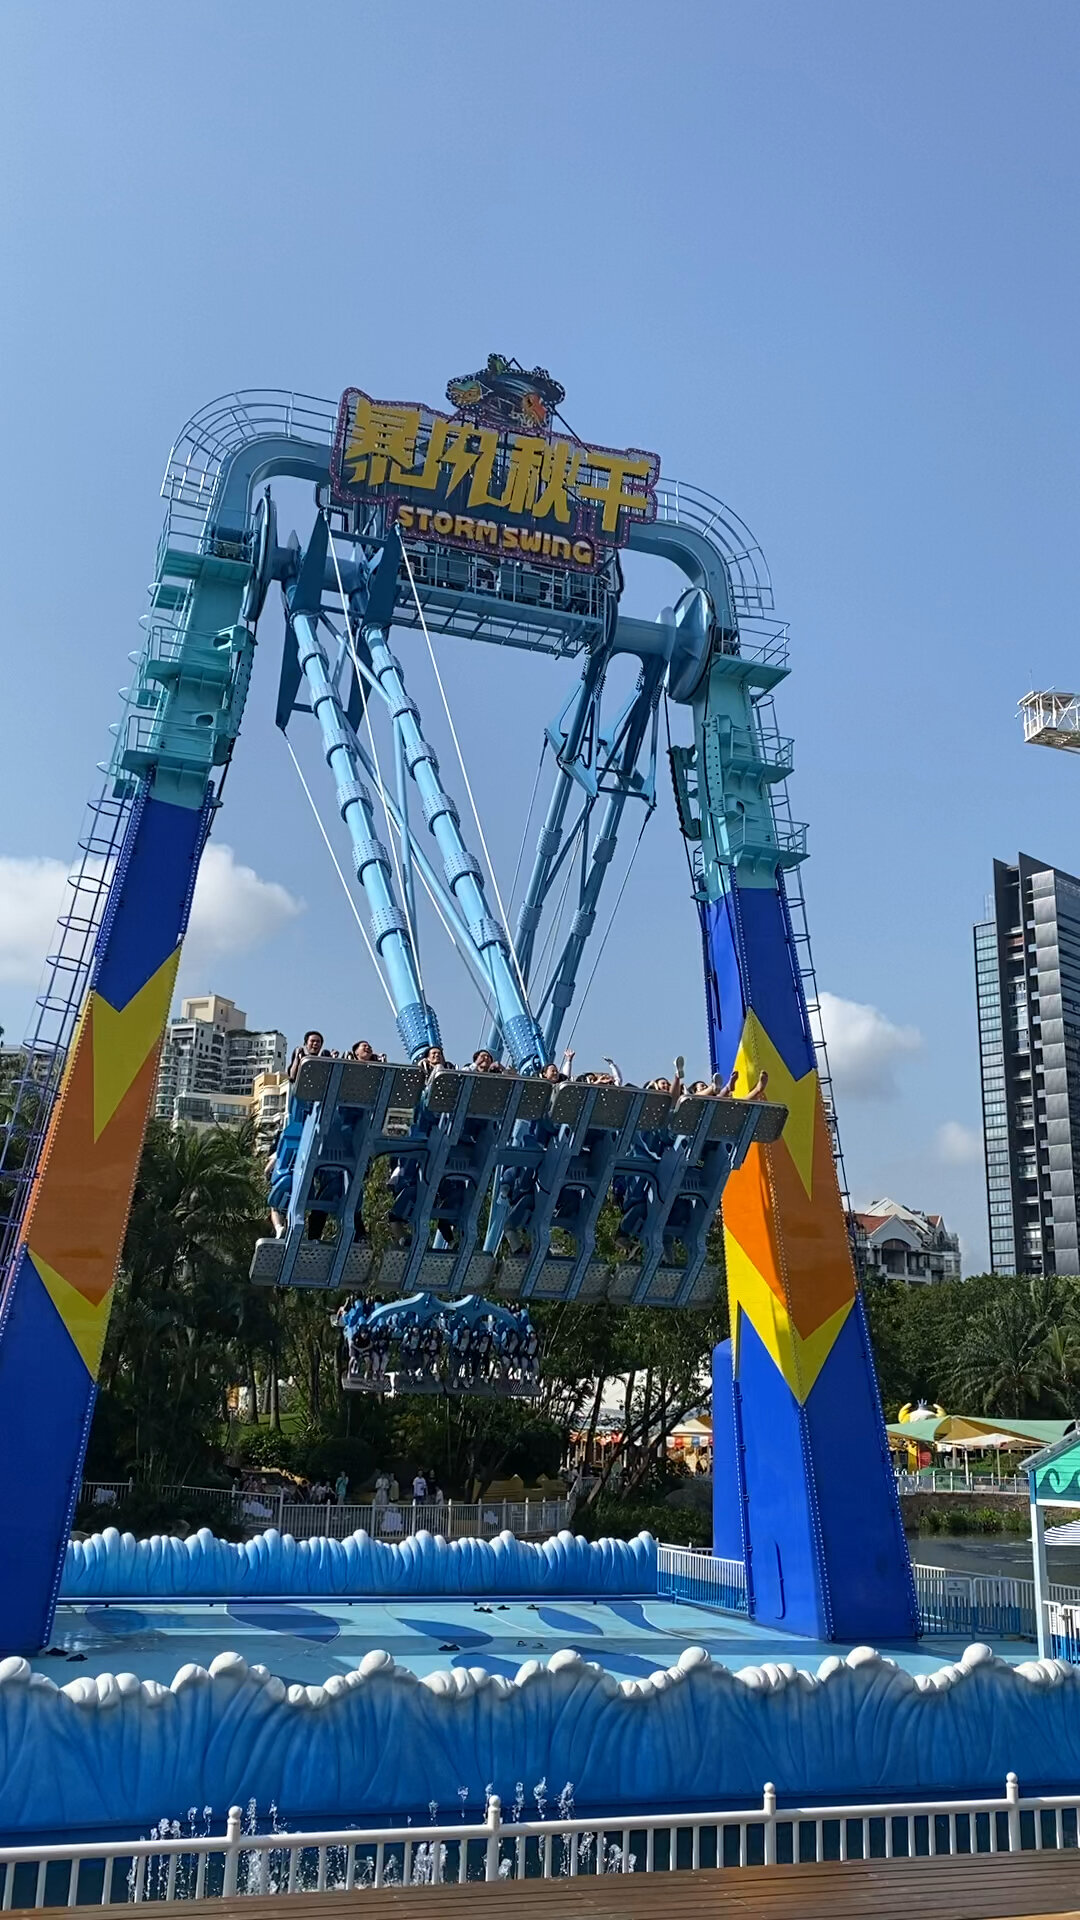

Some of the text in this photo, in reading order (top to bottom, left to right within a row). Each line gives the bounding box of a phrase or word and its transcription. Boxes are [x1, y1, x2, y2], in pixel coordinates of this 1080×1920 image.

[344, 397, 650, 532] 暴风秋千
[397, 505, 594, 564] STORM SWING
